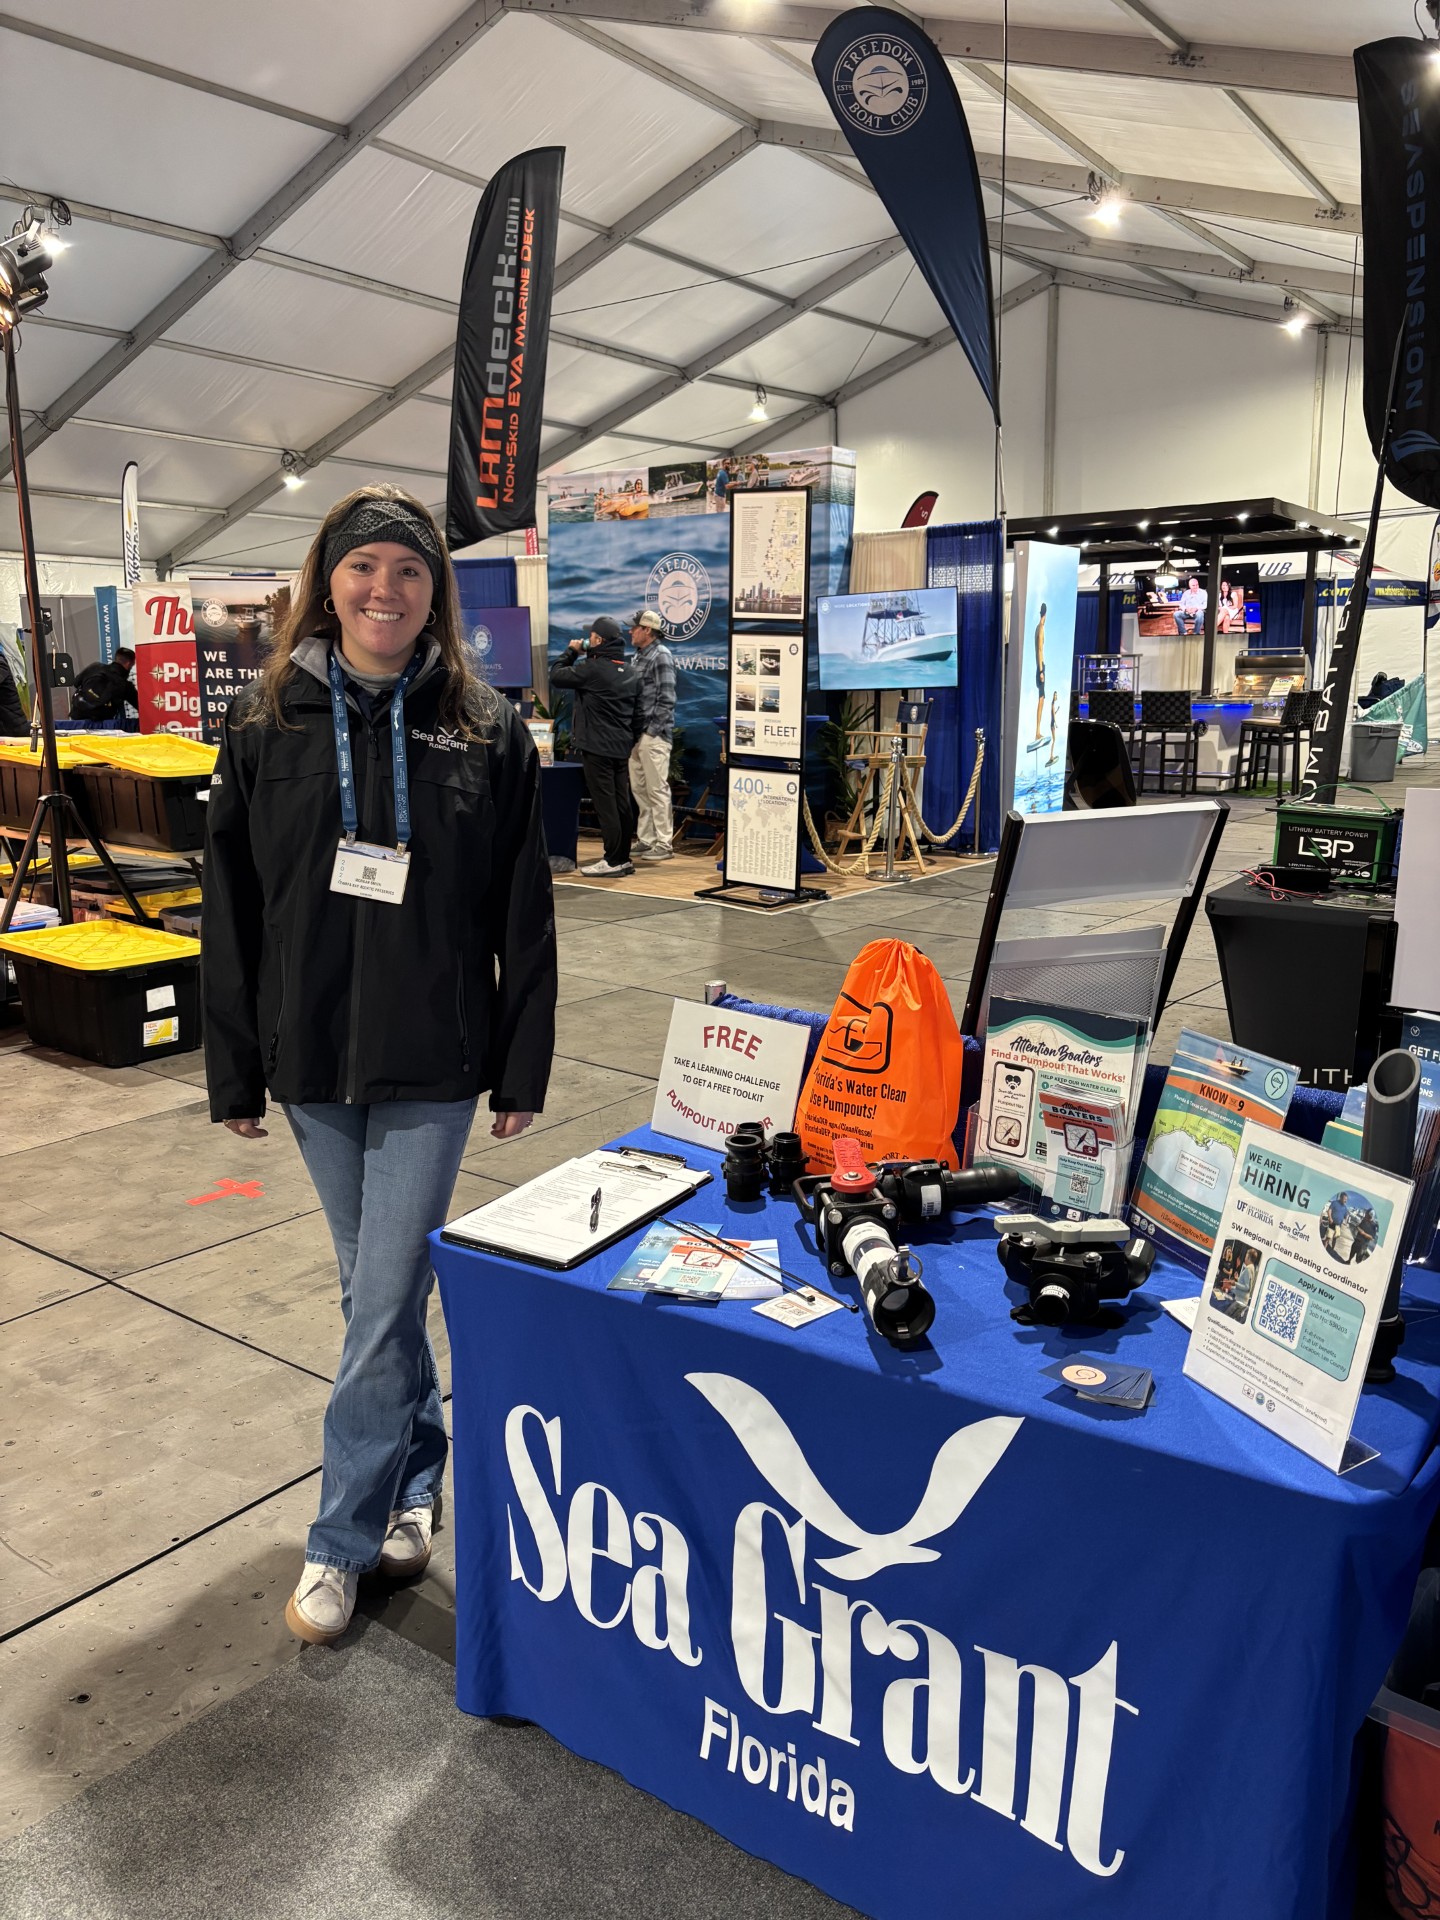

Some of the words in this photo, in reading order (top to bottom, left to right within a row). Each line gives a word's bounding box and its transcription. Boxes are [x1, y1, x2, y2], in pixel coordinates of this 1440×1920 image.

[843, 41, 914, 72] FREEDOM
[848, 102, 883, 129] BOAT
[890, 97, 919, 126] CLUB
[520, 207, 537, 263] DECK
[513, 267, 532, 348] MARINE
[508, 353, 526, 407] EVA
[654, 559, 703, 584] FREEDOM
[658, 611, 677, 635] OAT
[682, 608, 704, 633] CLUB
[204, 651, 227, 662] WE
[163, 662, 197, 683] Pri
[205, 668, 233, 679] ARE
[206, 685, 243, 696] LARG
[164, 691, 201, 717] Dig
[208, 702, 227, 712] BO
[209, 718, 223, 728] LI
[764, 725, 797, 737] FLEET
[411, 729, 434, 741] Sea
[437, 734, 468, 752] Grant
[734, 777, 772, 795] 400+
[703, 1025, 762, 1060] FREE
[1009, 1036, 1058, 1058] Attention
[1057, 1044, 1104, 1067] Boaters
[1409, 1045, 1430, 1058] GET
[674, 1056, 690, 1068] TAKE
[691, 1062, 696, 1070] A
[697, 1063, 733, 1079] LEARNING
[734, 1072, 781, 1091] CHALLENGE
[991, 1049, 1012, 1061] Find
[1013, 1054, 1019, 1062] a
[1021, 1054, 1065, 1072] Pumpout
[1067, 1063, 1089, 1076] That
[1091, 1068, 1126, 1083] Works!
[682, 1074, 692, 1083] TO
[693, 1077, 707, 1088] GET
[706, 1081, 712, 1089] A
[713, 1082, 731, 1095] FREE
[732, 1087, 764, 1103] TOOLKIT
[846, 1079, 878, 1097] Water
[881, 1083, 907, 1103] Clean
[1040, 1073, 1054, 1081] HELP
[1078, 1081, 1099, 1090] WATER
[1099, 1084, 1118, 1094] CLEAN
[666, 1089, 717, 1131] PUMPOUT
[823, 1094, 877, 1119] Pumpouts!
[1199, 1083, 1229, 1105] KNOW
[1237, 1100, 1245, 1112] 9
[1052, 1106, 1103, 1122] BOATERS
[1248, 1151, 1263, 1164] WE
[1263, 1157, 1282, 1172] ARE
[1243, 1164, 1311, 1210] HIRING
[1235, 1199, 1247, 1213] UF
[1247, 1207, 1274, 1227] FLORIDA
[1278, 1220, 1292, 1233] Sea
[1291, 1226, 1310, 1242] Grant
[1230, 1221, 1243, 1233] SW
[1242, 1227, 1272, 1249] Regional
[1272, 1241, 1293, 1258] Clean
[1292, 1251, 1322, 1274] Boating
[1321, 1265, 1368, 1296] Coordinator
[1297, 1276, 1318, 1294] Apply
[1317, 1286, 1335, 1301] Now
[504, 1404, 703, 1667] Sea
[731, 1501, 1140, 1877] Grant
[700, 1696, 856, 1832] Florida
